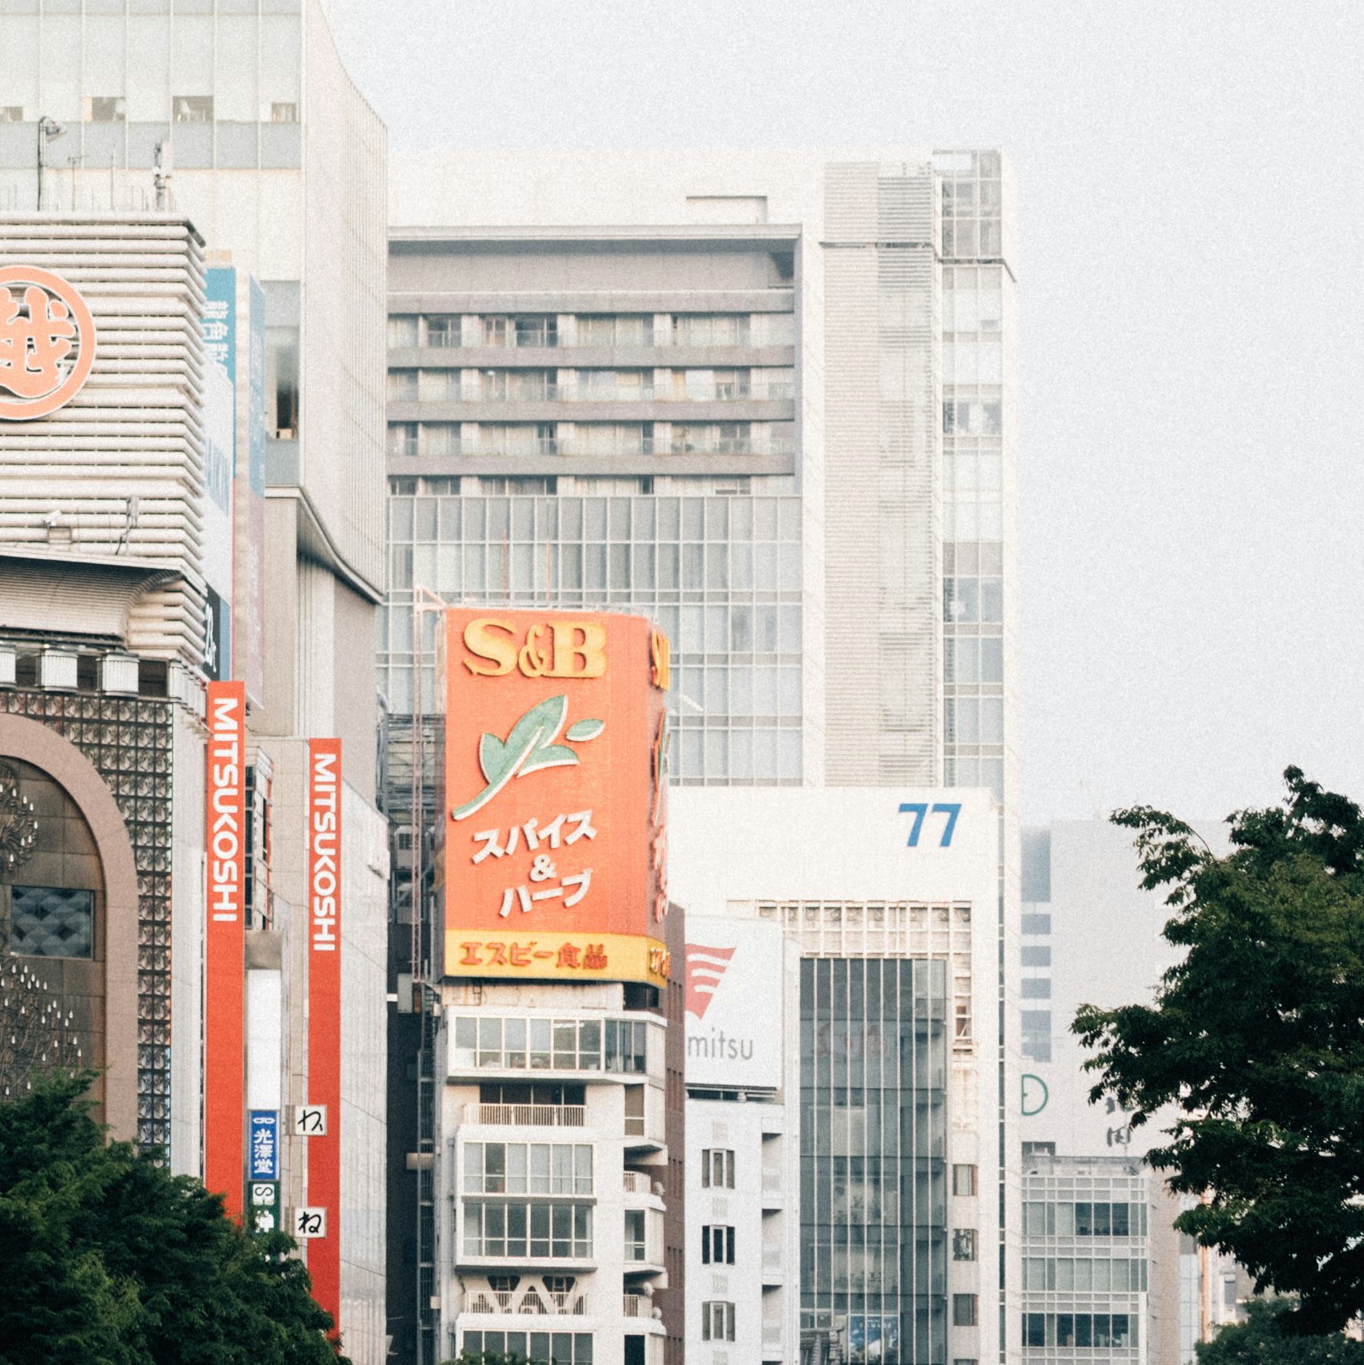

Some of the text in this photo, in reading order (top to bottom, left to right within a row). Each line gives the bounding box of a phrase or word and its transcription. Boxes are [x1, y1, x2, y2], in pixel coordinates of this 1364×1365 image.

[463, 618, 608, 679] S&B
[212, 697, 238, 922] MITSUKOSHI
[898, 803, 962, 847] 77
[313, 753, 337, 952] MITSUKOSHI
[472, 810, 598, 864] スパイス
[499, 869, 594, 918] ハーブ
[530, 855, 557, 882] &
[459, 941, 609, 970] エスビー食品
